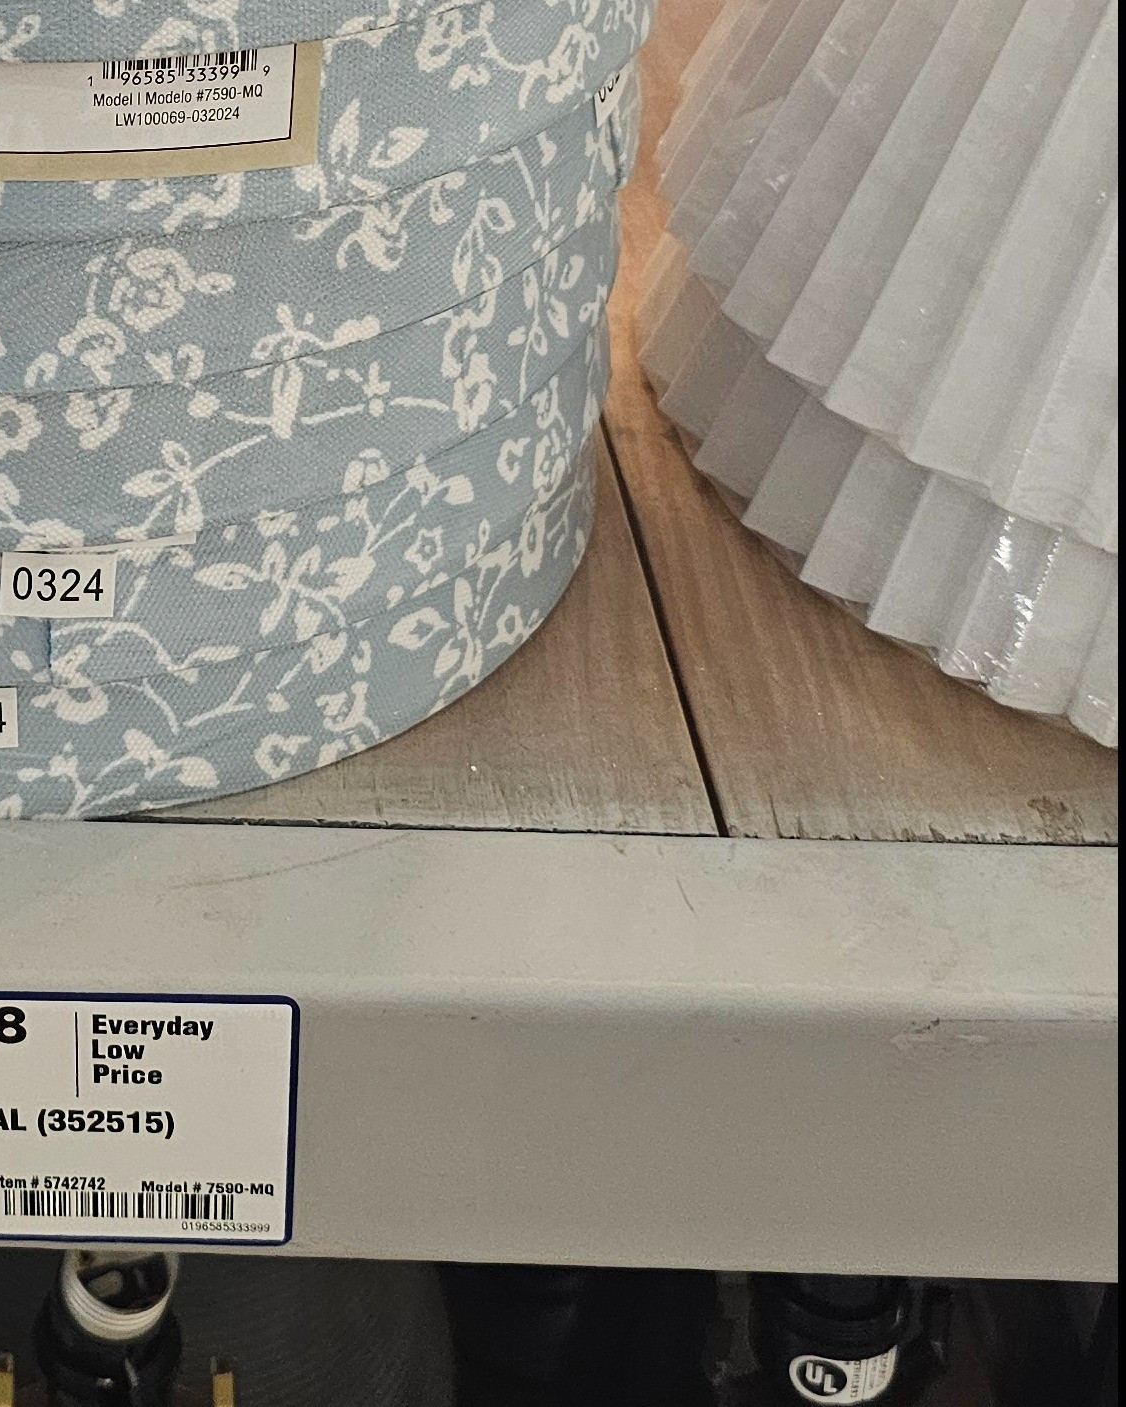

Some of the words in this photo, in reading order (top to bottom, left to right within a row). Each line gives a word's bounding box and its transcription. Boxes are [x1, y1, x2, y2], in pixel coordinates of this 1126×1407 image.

[121, 70, 176, 86] 96585
[185, 65, 240, 83] 33399
[93, 94, 133, 107] Model
[146, 91, 191, 105] Modelo
[196, 84, 263, 100] #7590-MQ
[115, 107, 240, 127] LW100069-032024
[12, 567, 104, 602] 0324
[92, 1015, 214, 1039] Everyday
[92, 1039, 145, 1060] Low
[93, 1065, 163, 1085] Price
[36, 1111, 175, 1139] (352515)
[44, 1176, 106, 1190] 5742742
[142, 1180, 187, 1193] Model
[206, 1182, 274, 1196] 7590-MQ
[806, 1362, 837, 1392] UL
